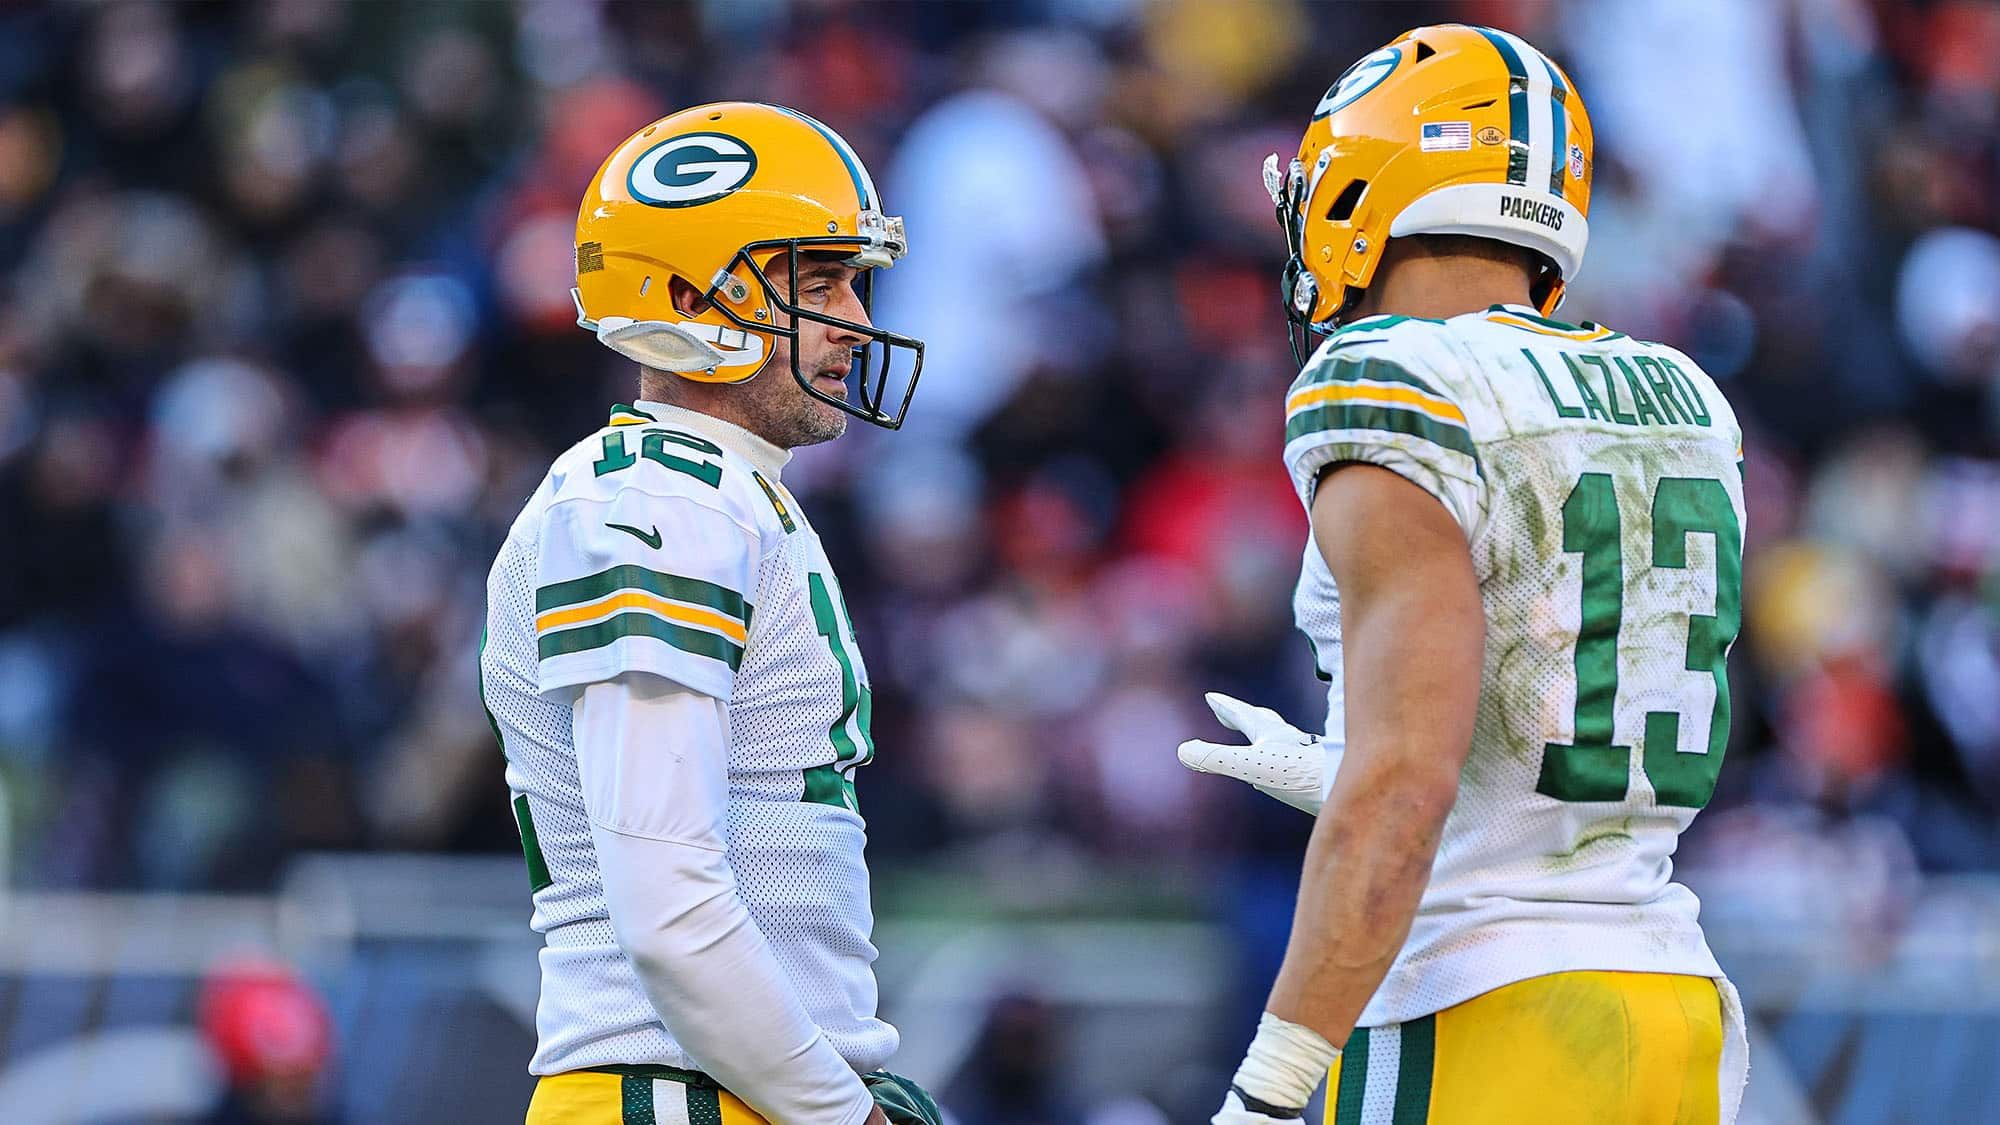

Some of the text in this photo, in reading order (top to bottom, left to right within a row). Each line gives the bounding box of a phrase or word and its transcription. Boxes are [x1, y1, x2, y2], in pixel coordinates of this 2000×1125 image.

[628, 132, 757, 208] G
[1500, 195, 1564, 231] PACKERS
[1520, 348, 1712, 427] LAZARD
[593, 428, 723, 489] 12
[1536, 473, 1742, 808] 13
